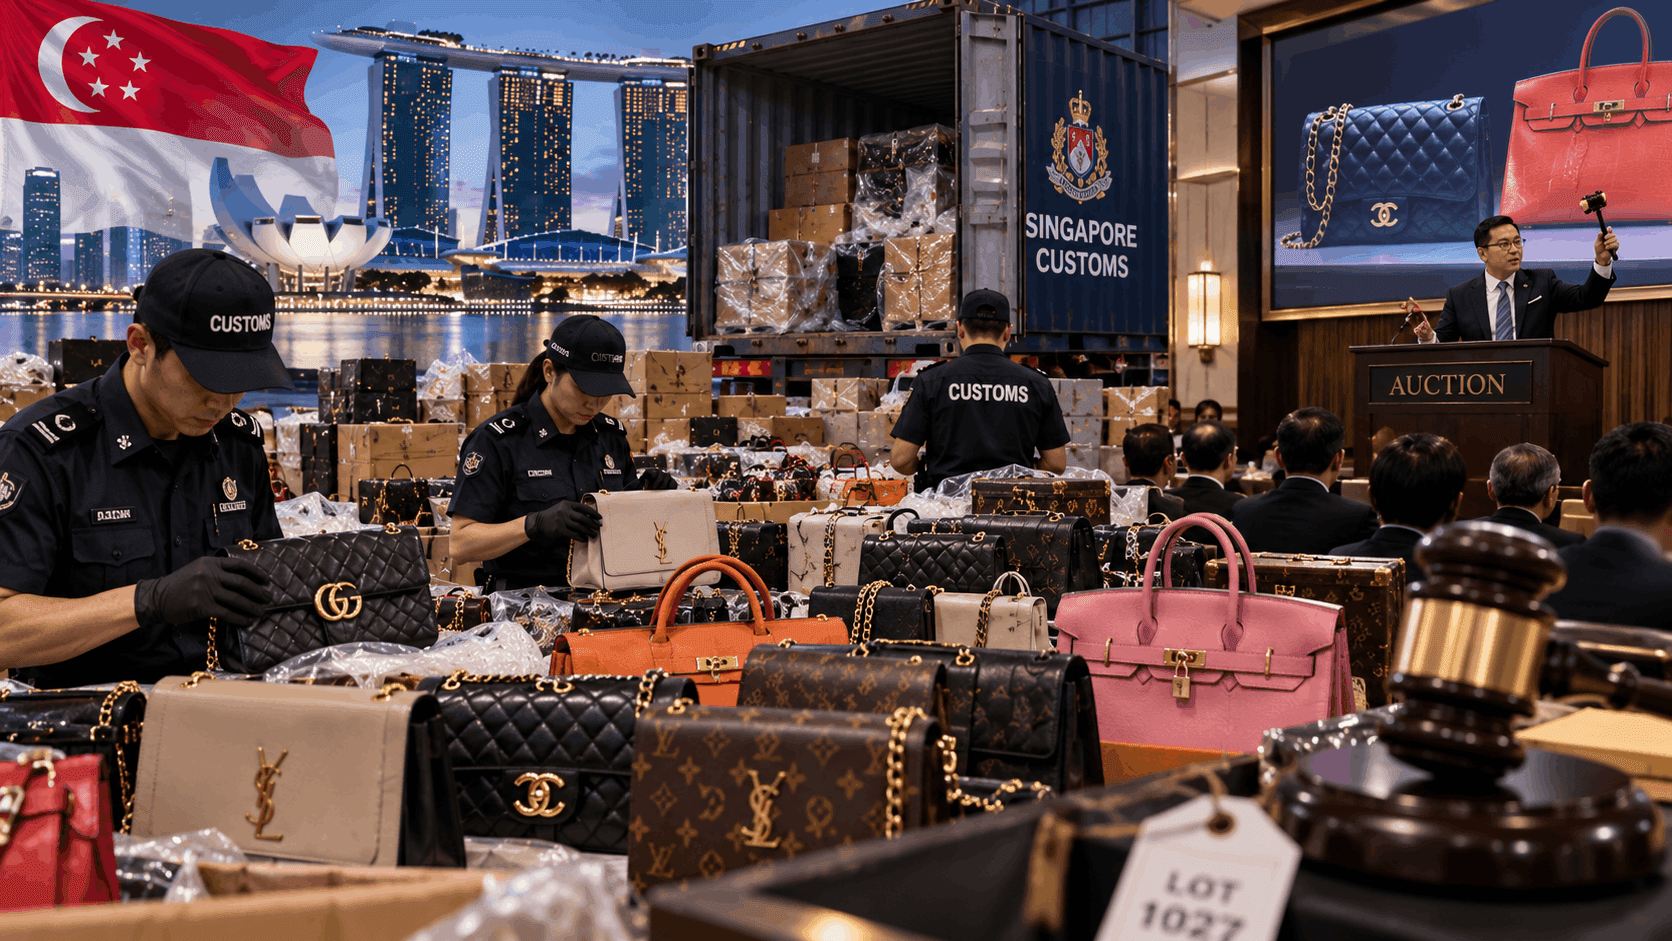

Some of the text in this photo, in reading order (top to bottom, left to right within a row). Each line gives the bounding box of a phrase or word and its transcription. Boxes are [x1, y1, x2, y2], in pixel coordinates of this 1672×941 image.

[1025, 213, 1138, 248] SINGAPORE
[1035, 247, 1129, 279] CUSTOMS
[210, 312, 272, 333] CUSTOMS
[948, 382, 1029, 404] CUSTOMS
[1389, 373, 1506, 396] AUCTION
[245, 746, 289, 842] YSL
[740, 769, 787, 848] YSL
[1165, 869, 1242, 904] LOT
[1140, 899, 1248, 941] 1027
